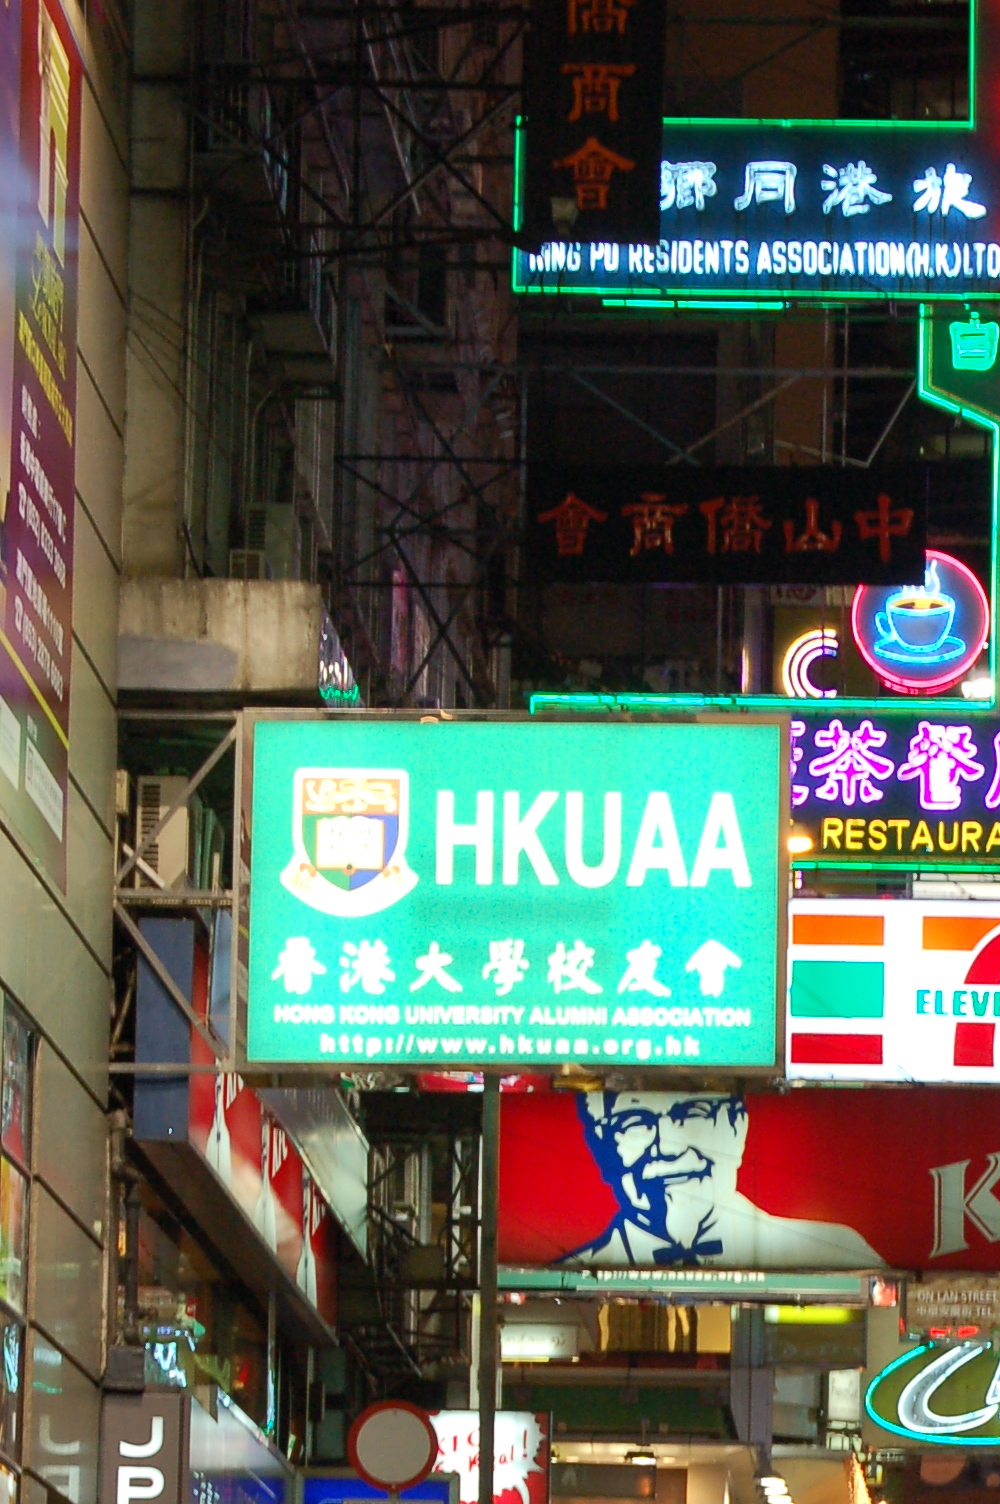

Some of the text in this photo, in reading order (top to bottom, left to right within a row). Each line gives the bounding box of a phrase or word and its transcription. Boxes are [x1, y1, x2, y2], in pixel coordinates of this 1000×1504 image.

[628, 239, 750, 275] RESIDENTS
[435, 789, 753, 889] HKUAA
[273, 1004, 751, 1028] HONG KONG UNIVERSITY ALUMNI ASSOCIATION
[937, 1291, 956, 1304] LAN
